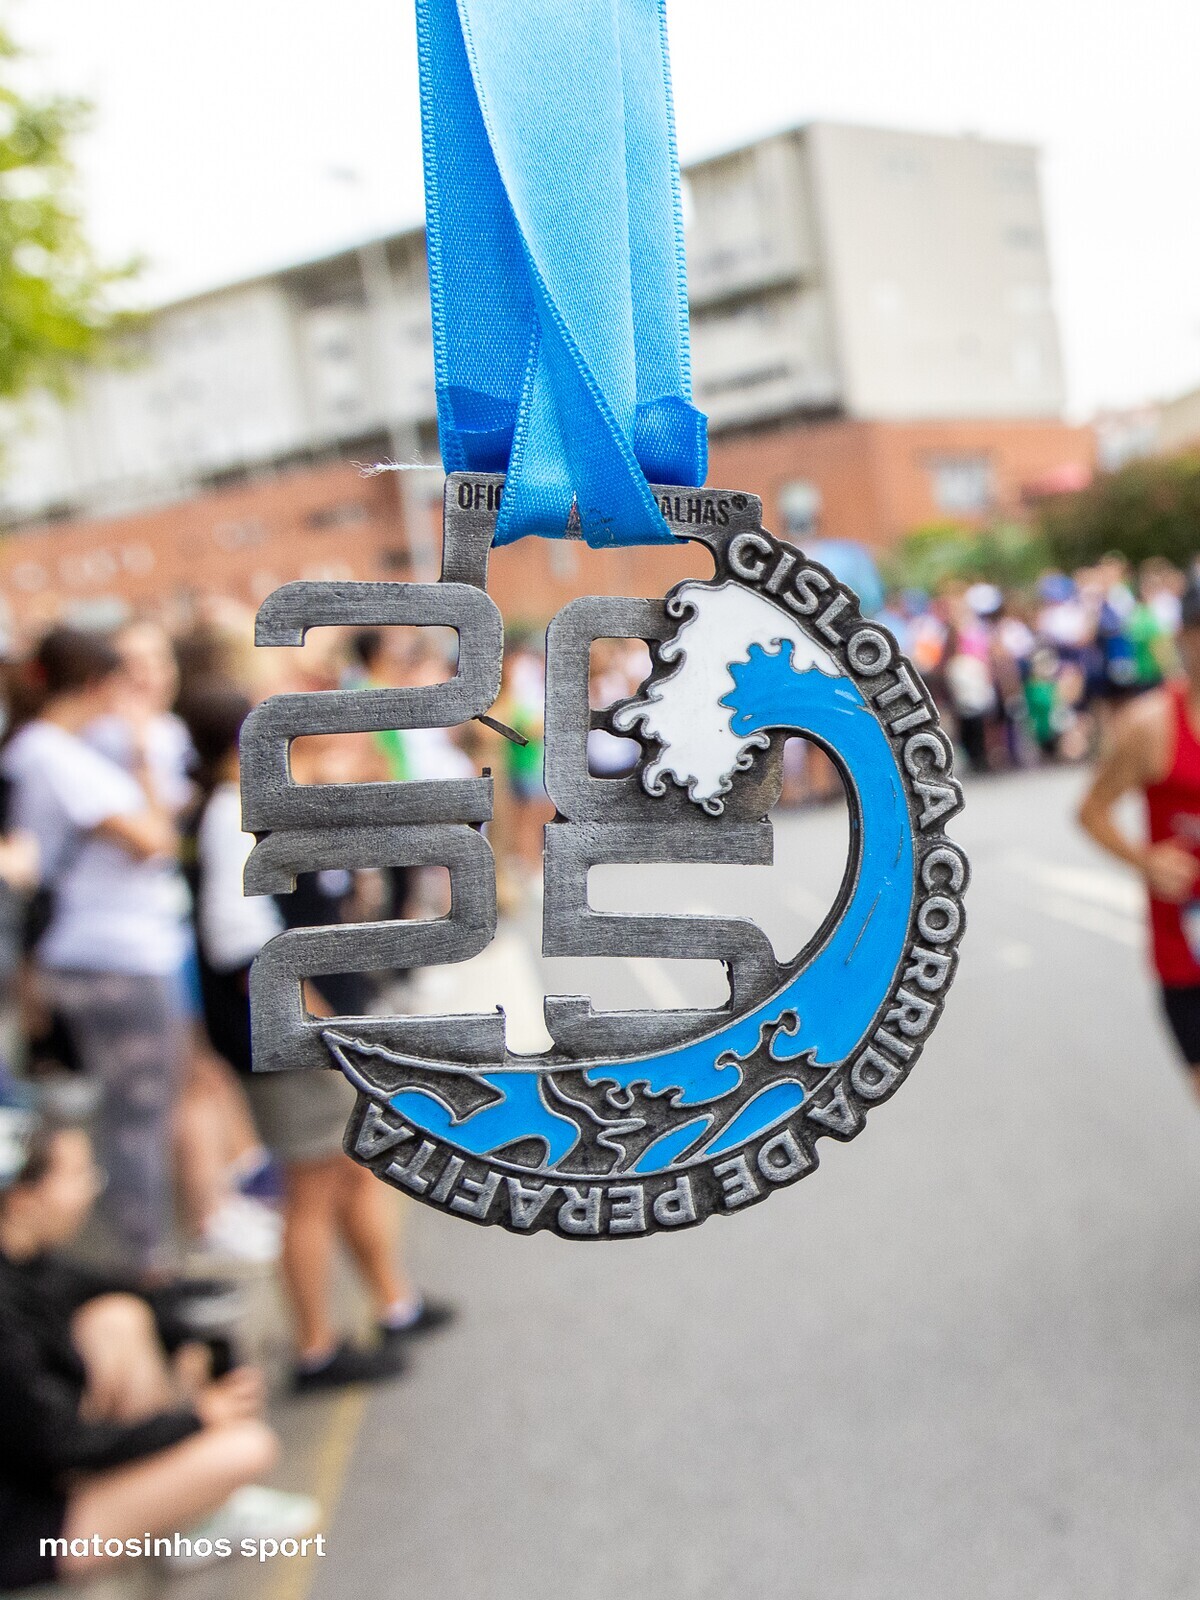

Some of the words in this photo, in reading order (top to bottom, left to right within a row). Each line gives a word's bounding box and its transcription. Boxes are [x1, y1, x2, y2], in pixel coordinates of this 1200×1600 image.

[654, 495, 730, 527] ALHAS
[728, 533, 957, 830] GISLOTICA
[807, 847, 965, 1138] CORRIDA
[354, 1102, 697, 1235] PERAFITA
[713, 1128, 812, 1209] DE
